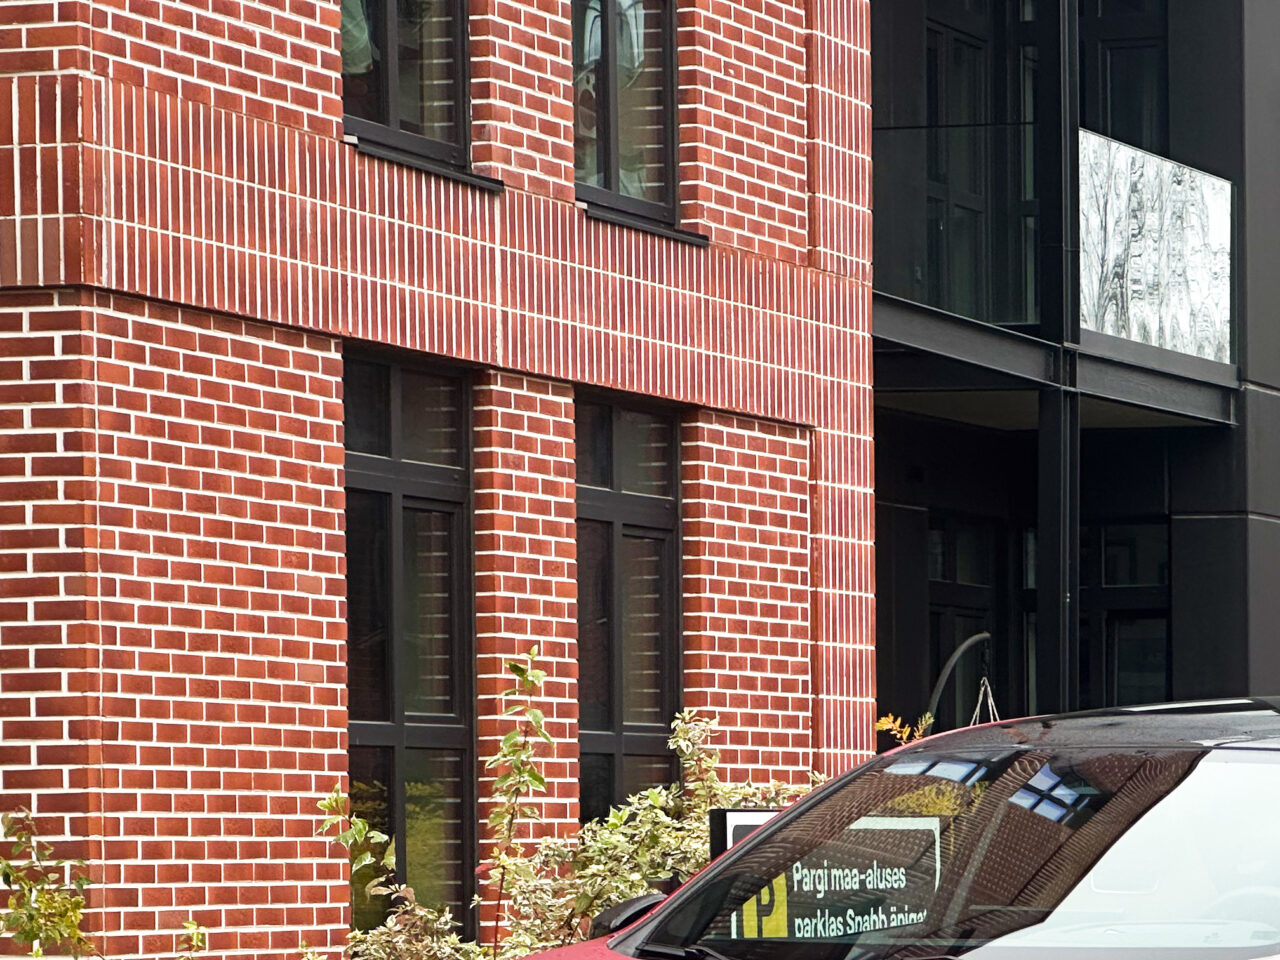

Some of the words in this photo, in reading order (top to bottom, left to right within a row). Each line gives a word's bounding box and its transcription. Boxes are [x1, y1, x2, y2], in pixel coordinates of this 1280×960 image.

[793, 860, 829, 898] Pargi
[831, 860, 906, 891] maa-aluses
[794, 908, 844, 938] parklas
